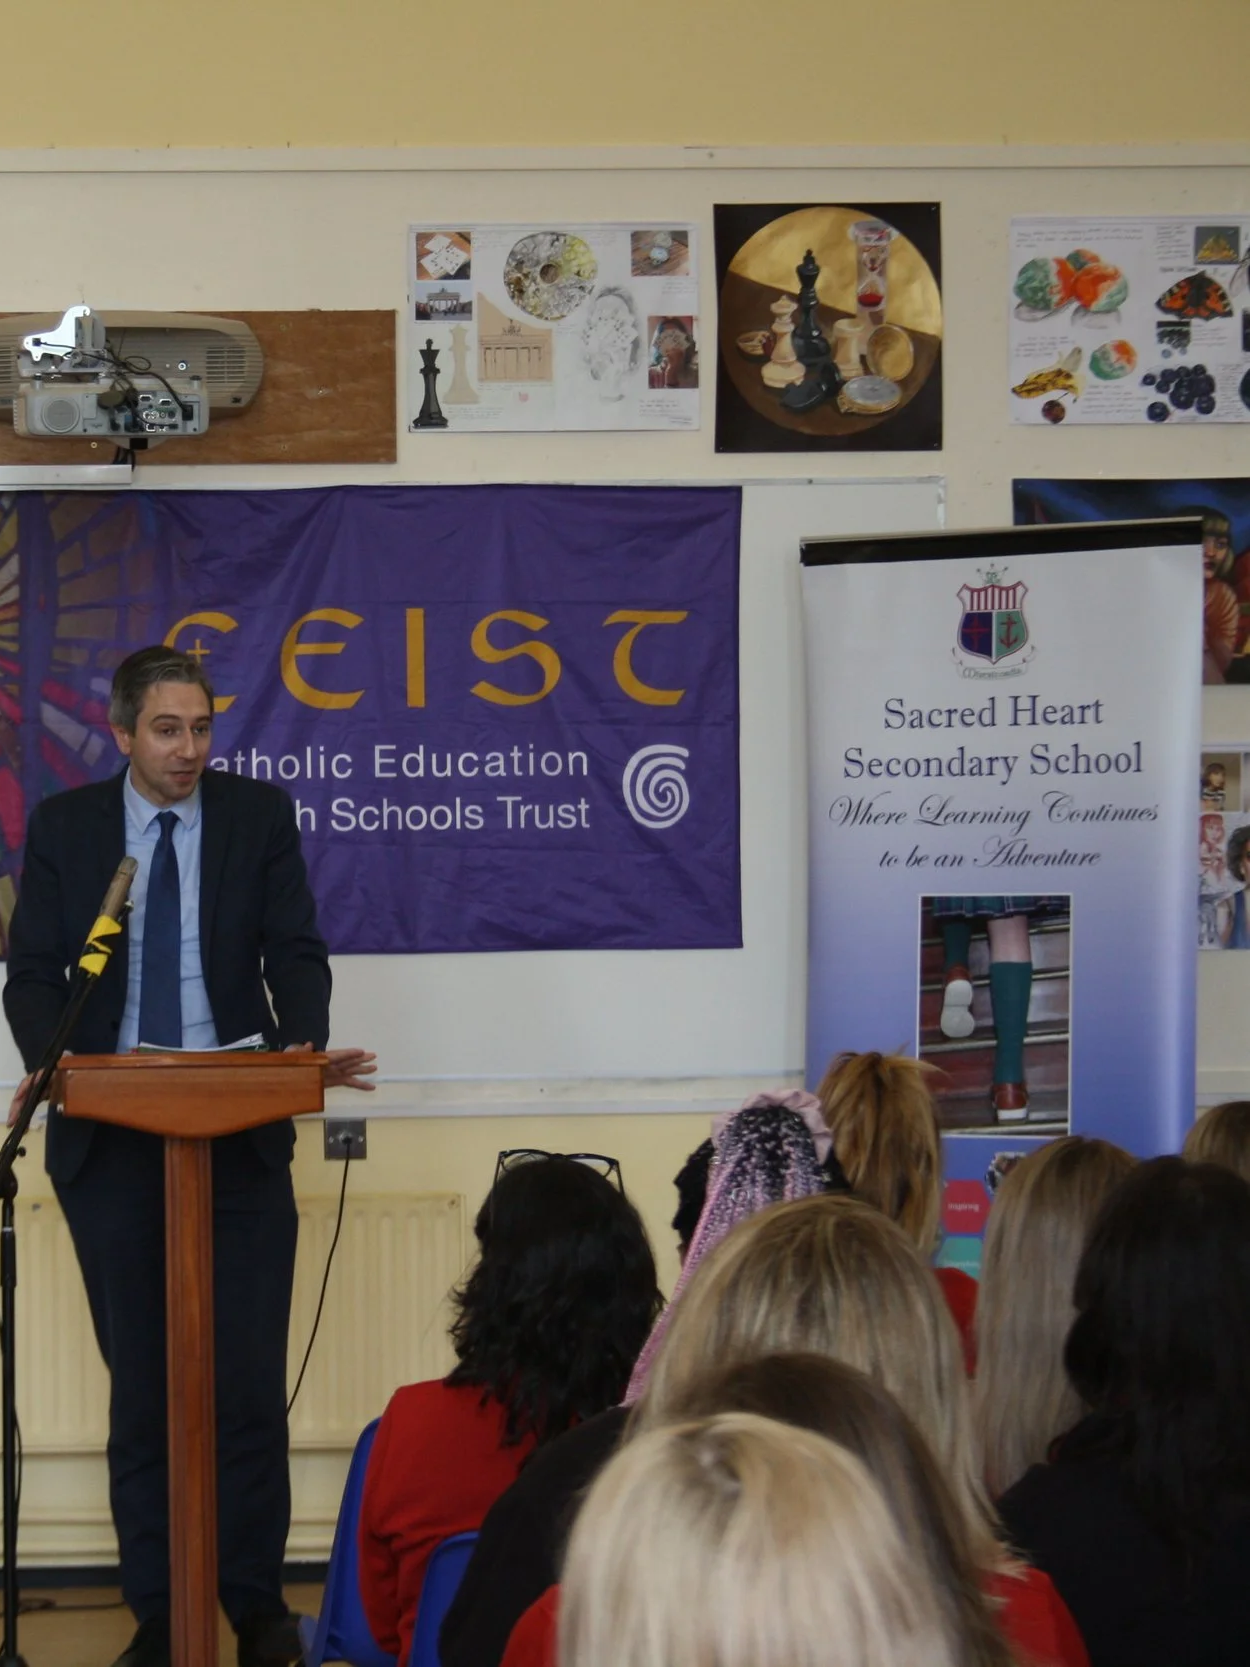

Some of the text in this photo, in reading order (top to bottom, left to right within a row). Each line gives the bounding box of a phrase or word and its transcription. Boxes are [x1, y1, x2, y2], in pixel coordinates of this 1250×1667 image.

[884, 694, 1105, 730] Sacred Heart
[209, 744, 589, 781] atholic Education
[844, 741, 1144, 786] Secondary School
[330, 797, 485, 832] Schools
[496, 796, 591, 829] Trust
[828, 790, 1160, 837] Where Learning Continues
[879, 835, 1102, 868] to be an Adventure
